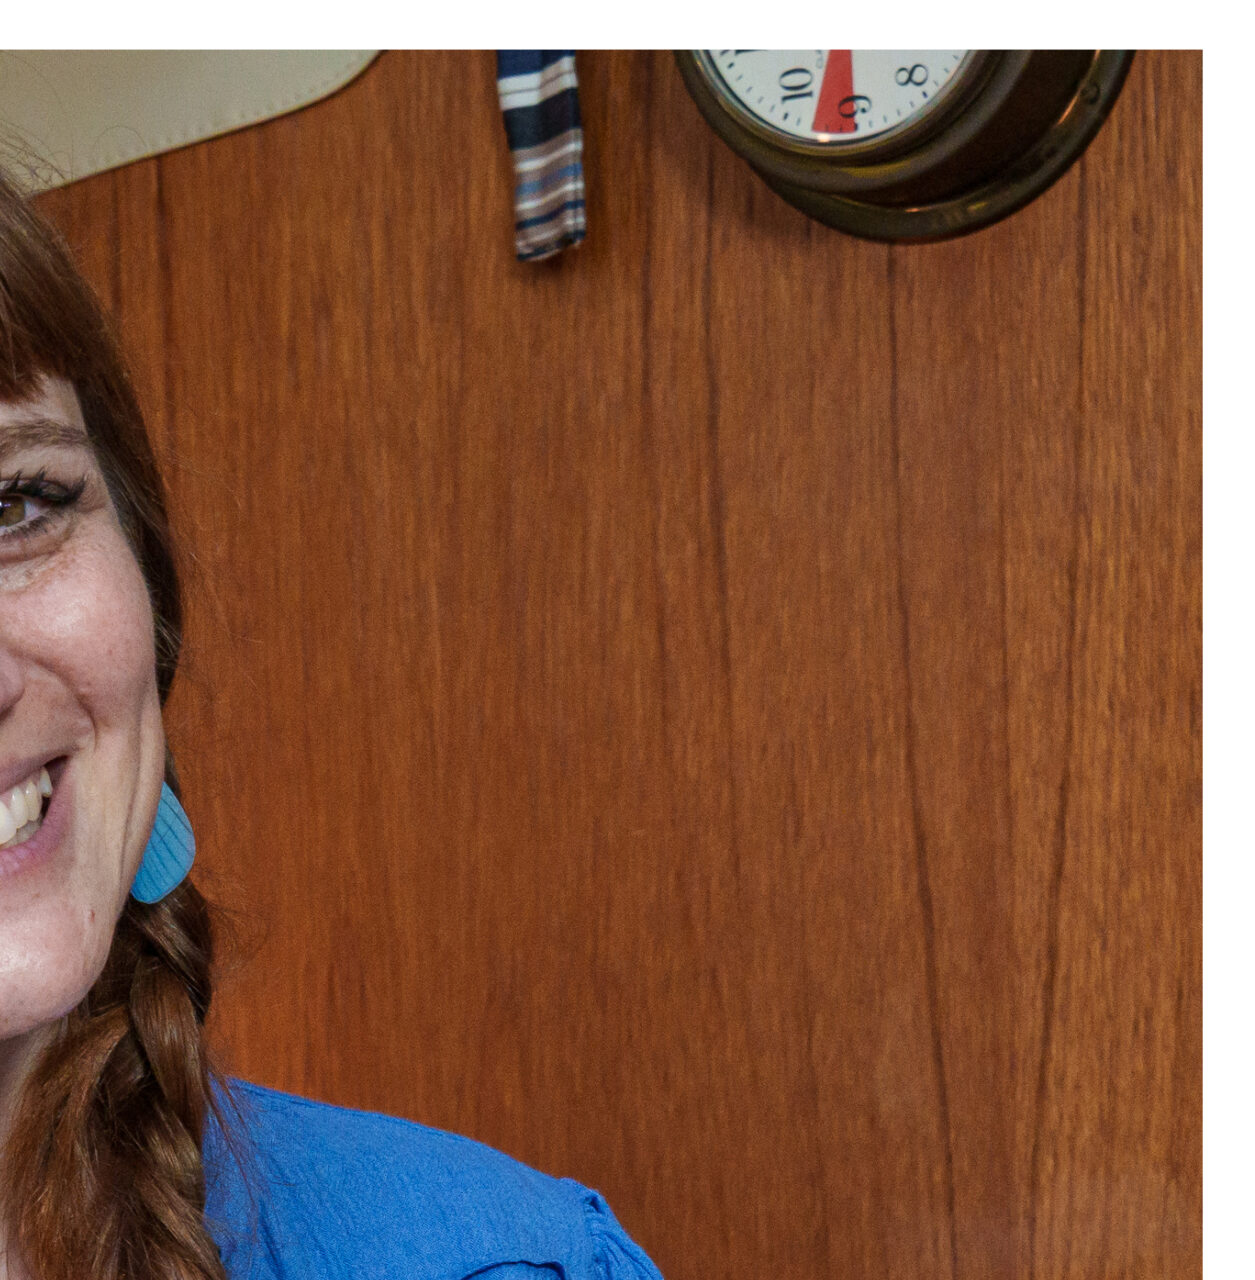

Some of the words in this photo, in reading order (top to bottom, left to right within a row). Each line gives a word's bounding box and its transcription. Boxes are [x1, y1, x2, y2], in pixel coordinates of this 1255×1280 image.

[779, 67, 814, 104] 10
[895, 63, 929, 86] 8
[838, 94, 872, 118] 9
